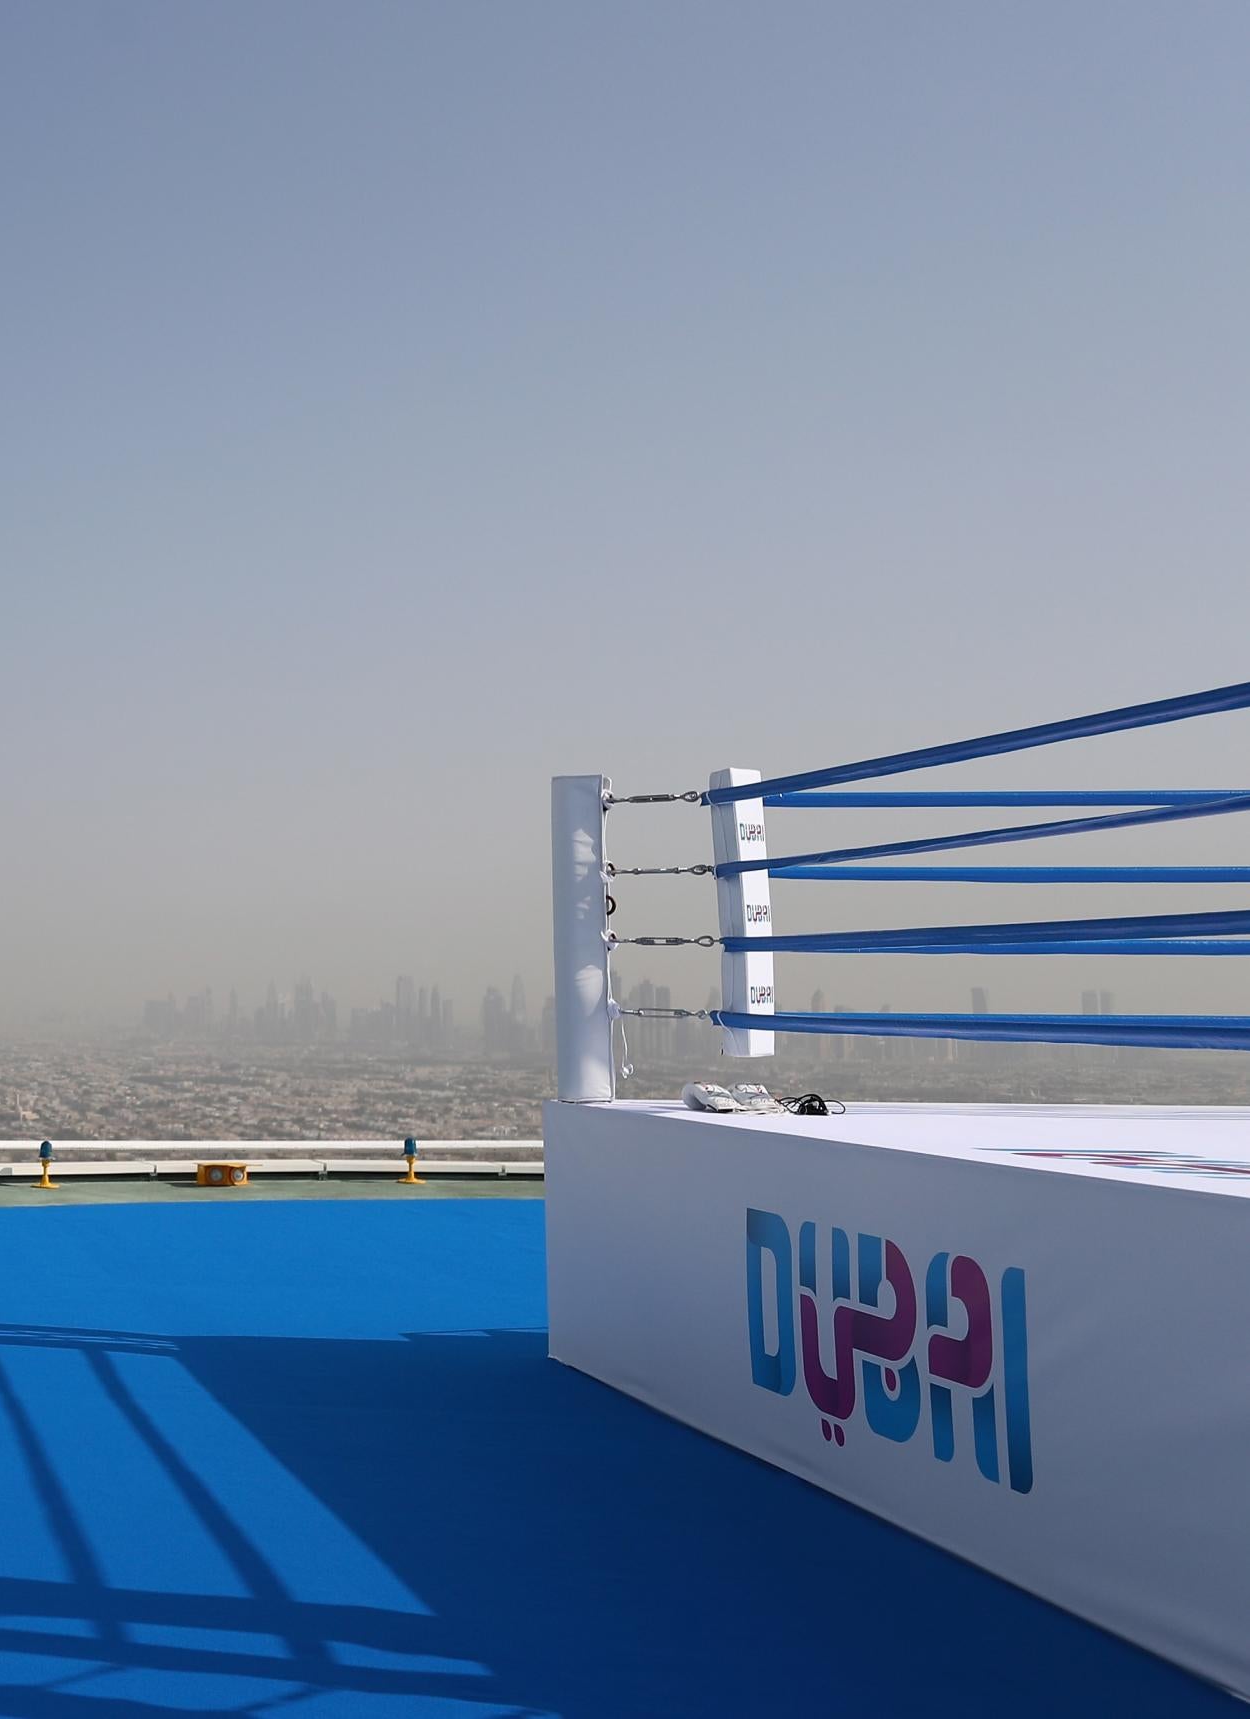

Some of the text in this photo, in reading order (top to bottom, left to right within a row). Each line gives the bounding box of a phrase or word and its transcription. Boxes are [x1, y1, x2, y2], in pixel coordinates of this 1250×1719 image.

[739, 823, 765, 840] DUBAI
[746, 904, 770, 921] DUBAI
[750, 986, 773, 1003] DUBAI
[746, 1207, 1033, 1495] DUBAI
